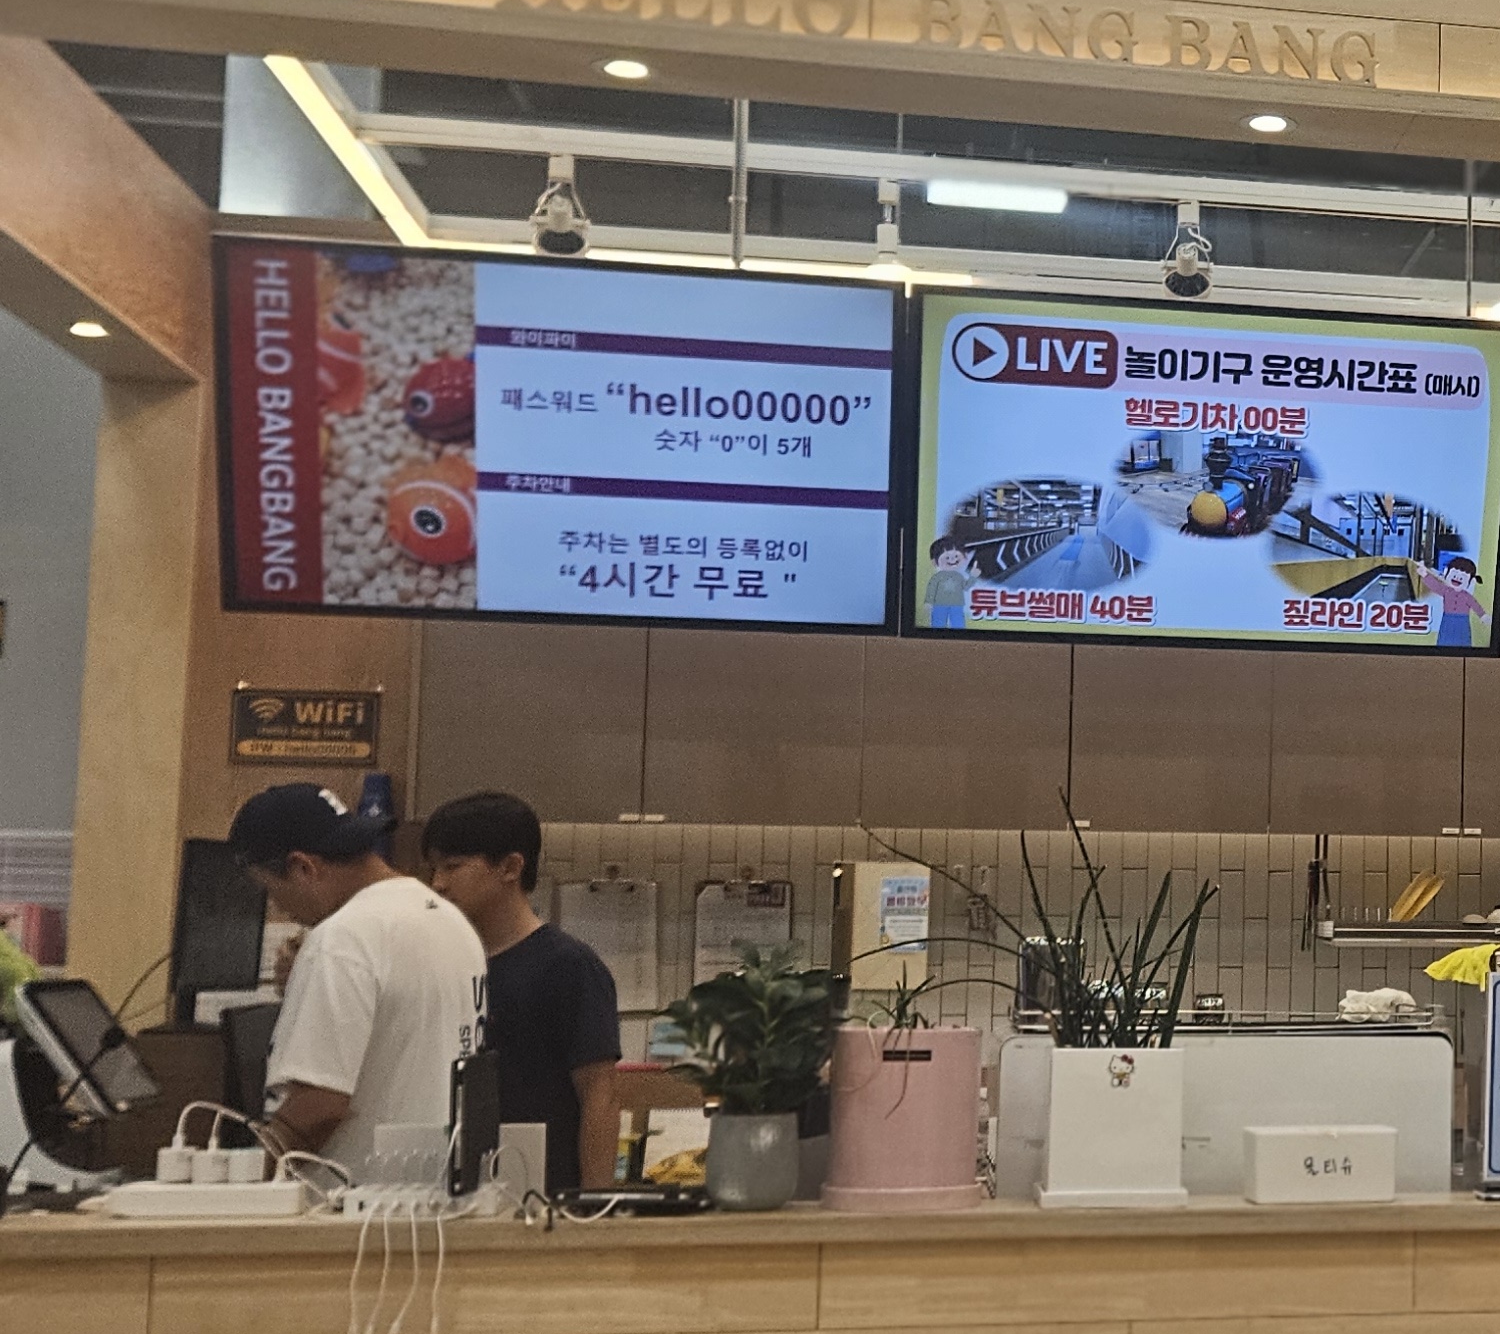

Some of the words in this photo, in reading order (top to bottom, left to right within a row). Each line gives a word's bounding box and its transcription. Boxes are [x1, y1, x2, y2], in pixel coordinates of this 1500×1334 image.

[1166, 12, 1380, 89] BANG
[254, 260, 292, 376] HELLO
[510, 329, 577, 349] 와이파이
[1017, 336, 1108, 374] LIVE
[1125, 345, 1254, 385] 놀이기구
[1261, 352, 1417, 394] 운영시간표
[1425, 372, 1480, 398] (매시)
[501, 388, 598, 414] 패스워드
[1125, 398, 1238, 431] 헬로기차
[1244, 405, 1307, 435] 00분
[654, 429, 700, 453] 숫자
[777, 436, 812, 459] 5개
[258, 387, 298, 592] BANGBANG
[505, 474, 571, 493] 주차안내
[558, 532, 630, 556] 주차는
[639, 534, 708, 559] 별도의
[717, 538, 808, 563] 등록없이
[693, 568, 769, 602] 무료
[970, 589, 1083, 621] 튜브썰매
[1089, 594, 1153, 624] 40분
[1370, 603, 1430, 632] 20분
